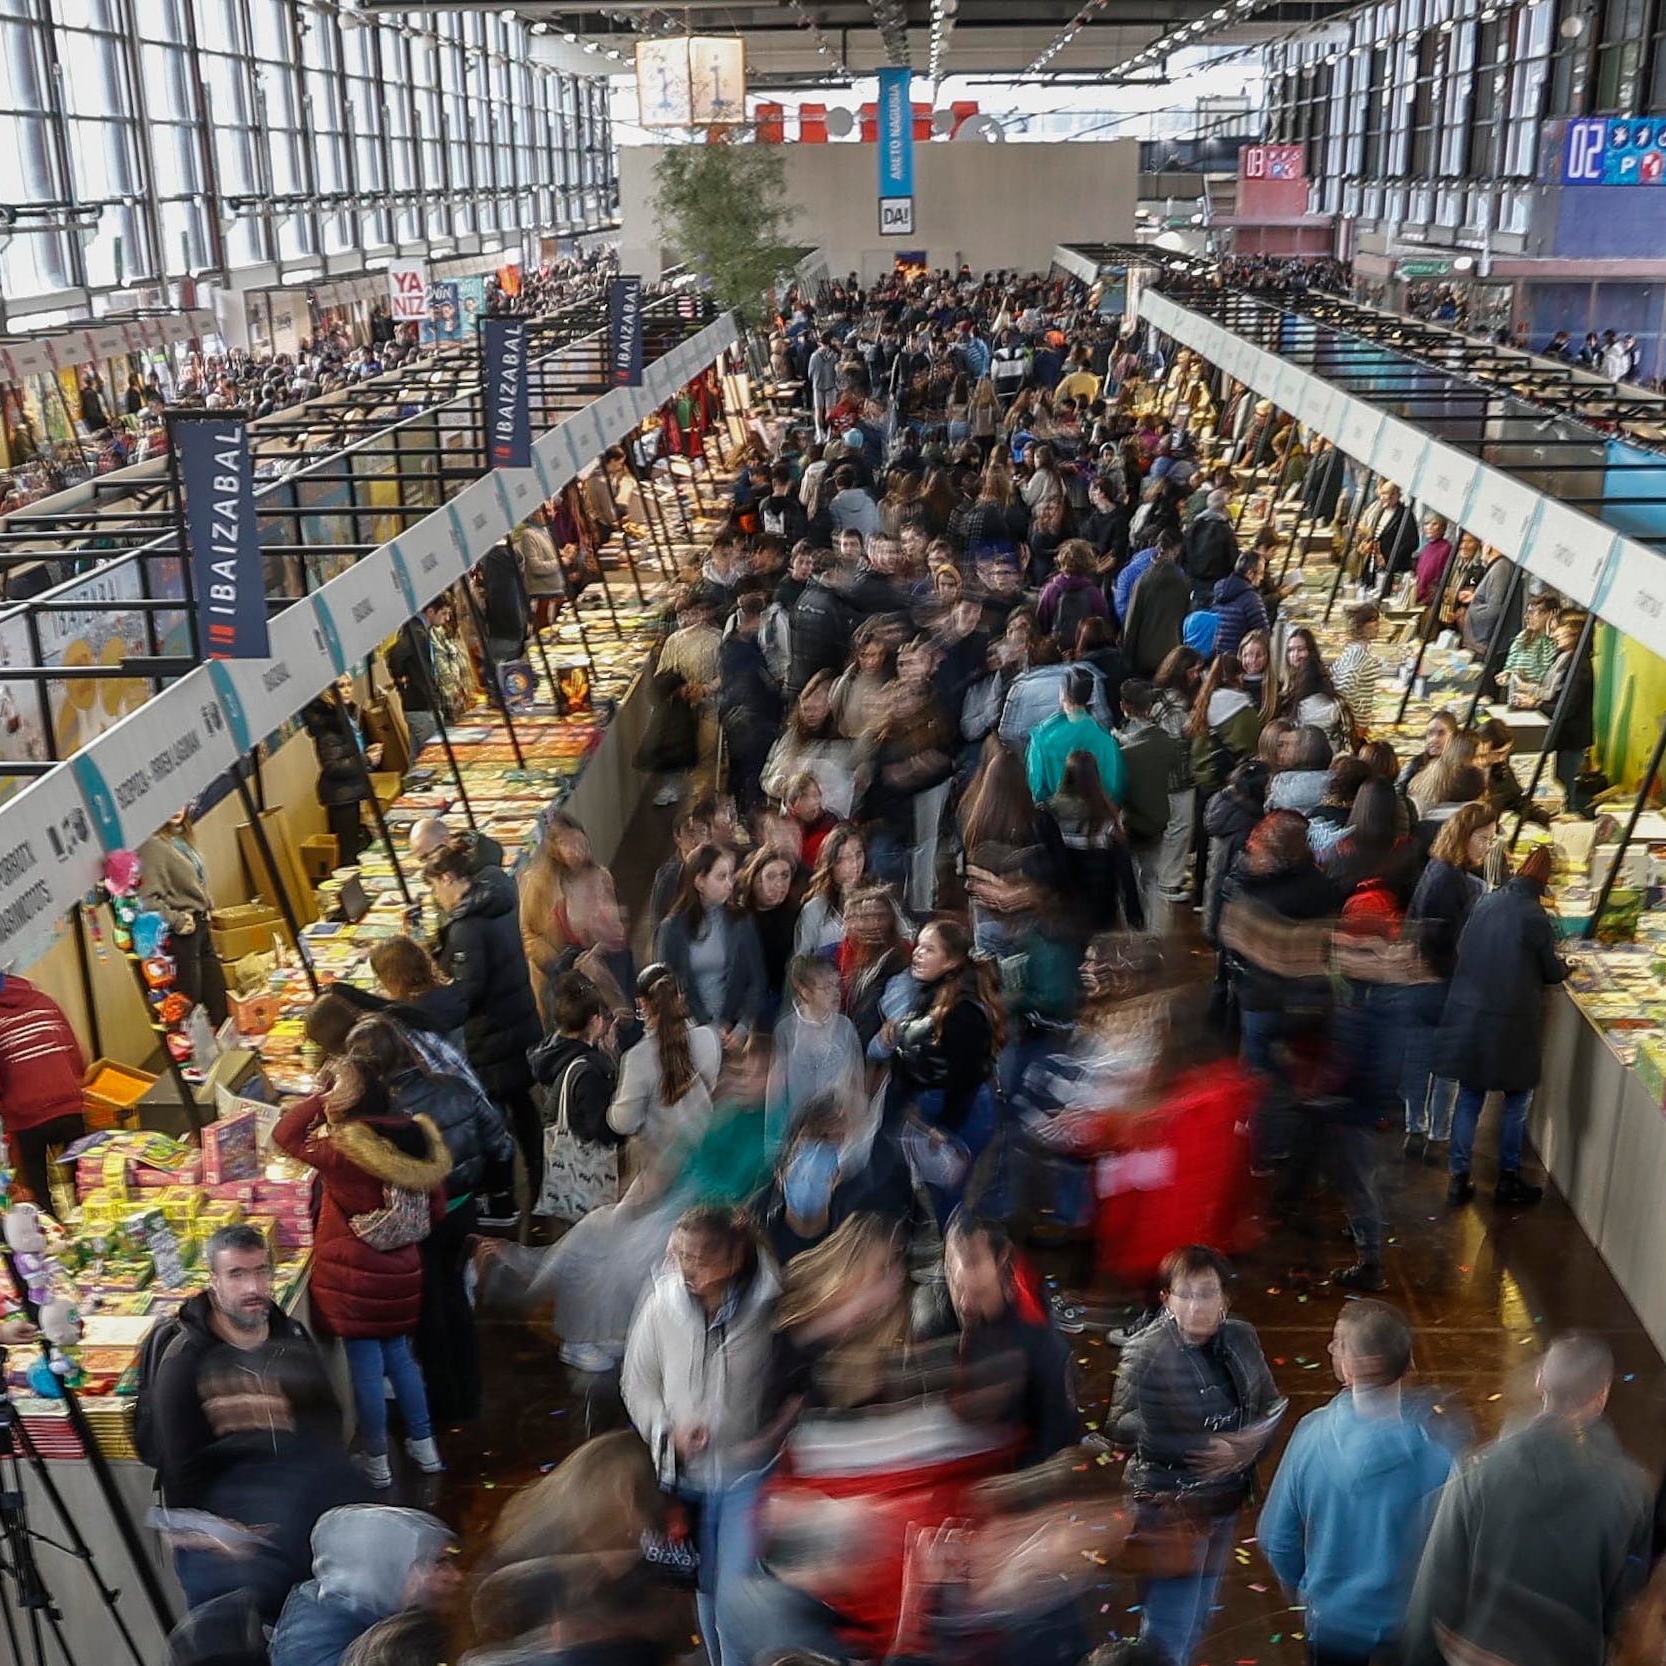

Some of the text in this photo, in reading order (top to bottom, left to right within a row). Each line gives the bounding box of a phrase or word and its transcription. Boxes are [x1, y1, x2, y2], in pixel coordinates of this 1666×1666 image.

[1247, 149, 1264, 176] 03
[1567, 124, 1604, 179] 02
[884, 206, 910, 226] DA!
[394, 272, 423, 293] YA
[393, 295, 425, 315] NIZ
[613, 286, 639, 369] IBAIZABAL
[495, 324, 523, 441] IBAIZABAL
[209, 428, 241, 615] IBAIZABAL
